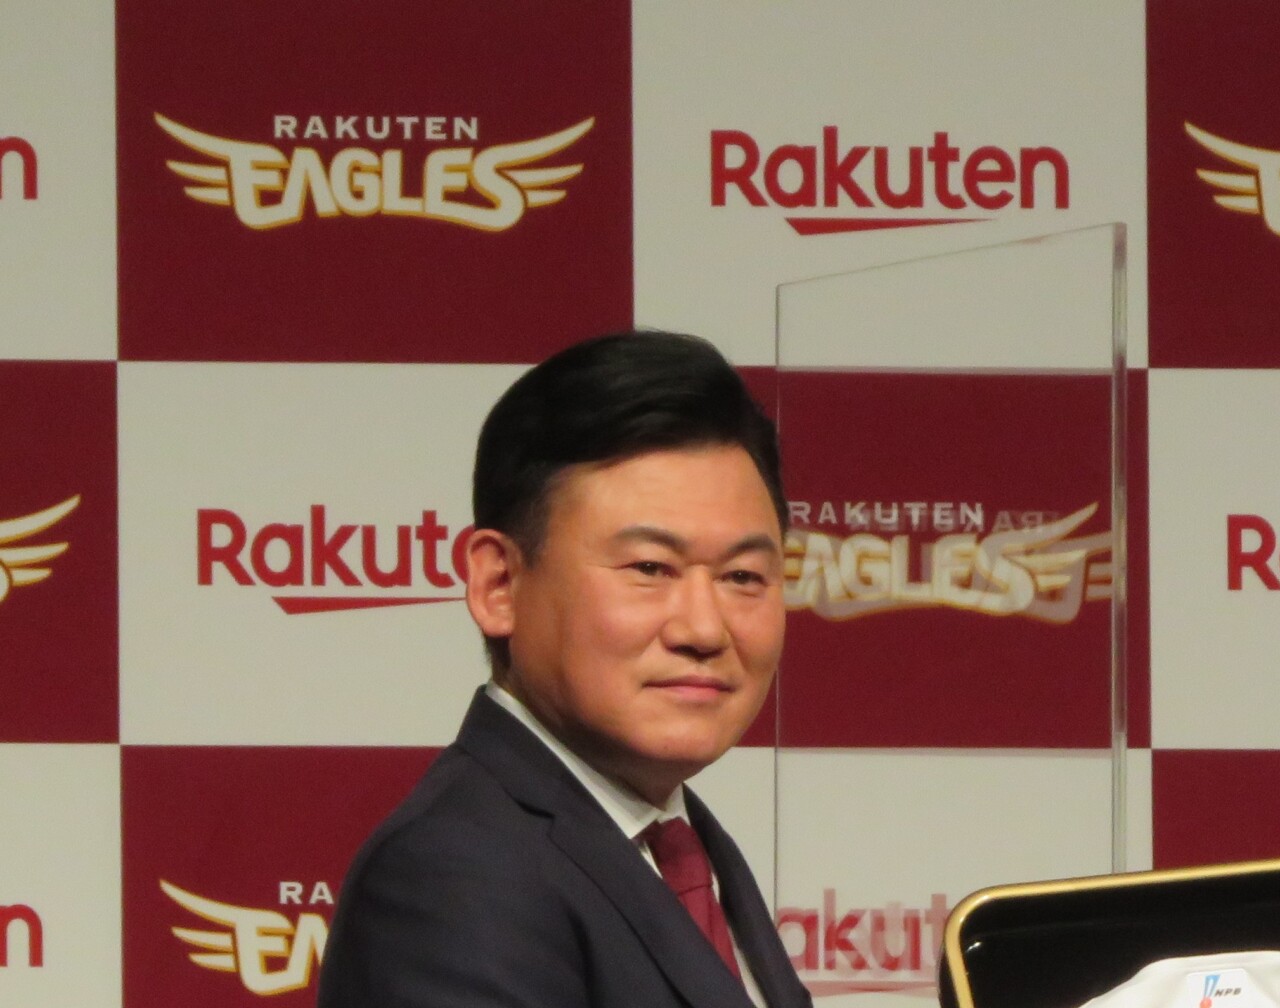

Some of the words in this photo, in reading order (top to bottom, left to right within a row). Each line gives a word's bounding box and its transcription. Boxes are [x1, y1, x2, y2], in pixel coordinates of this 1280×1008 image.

[274, 115, 478, 141] RAKUTEN
[711, 126, 1070, 210] Rakuten
[228, 143, 531, 232] EAGLES
[197, 504, 475, 588] Rakut
[788, 501, 985, 529] RAKUTEN
